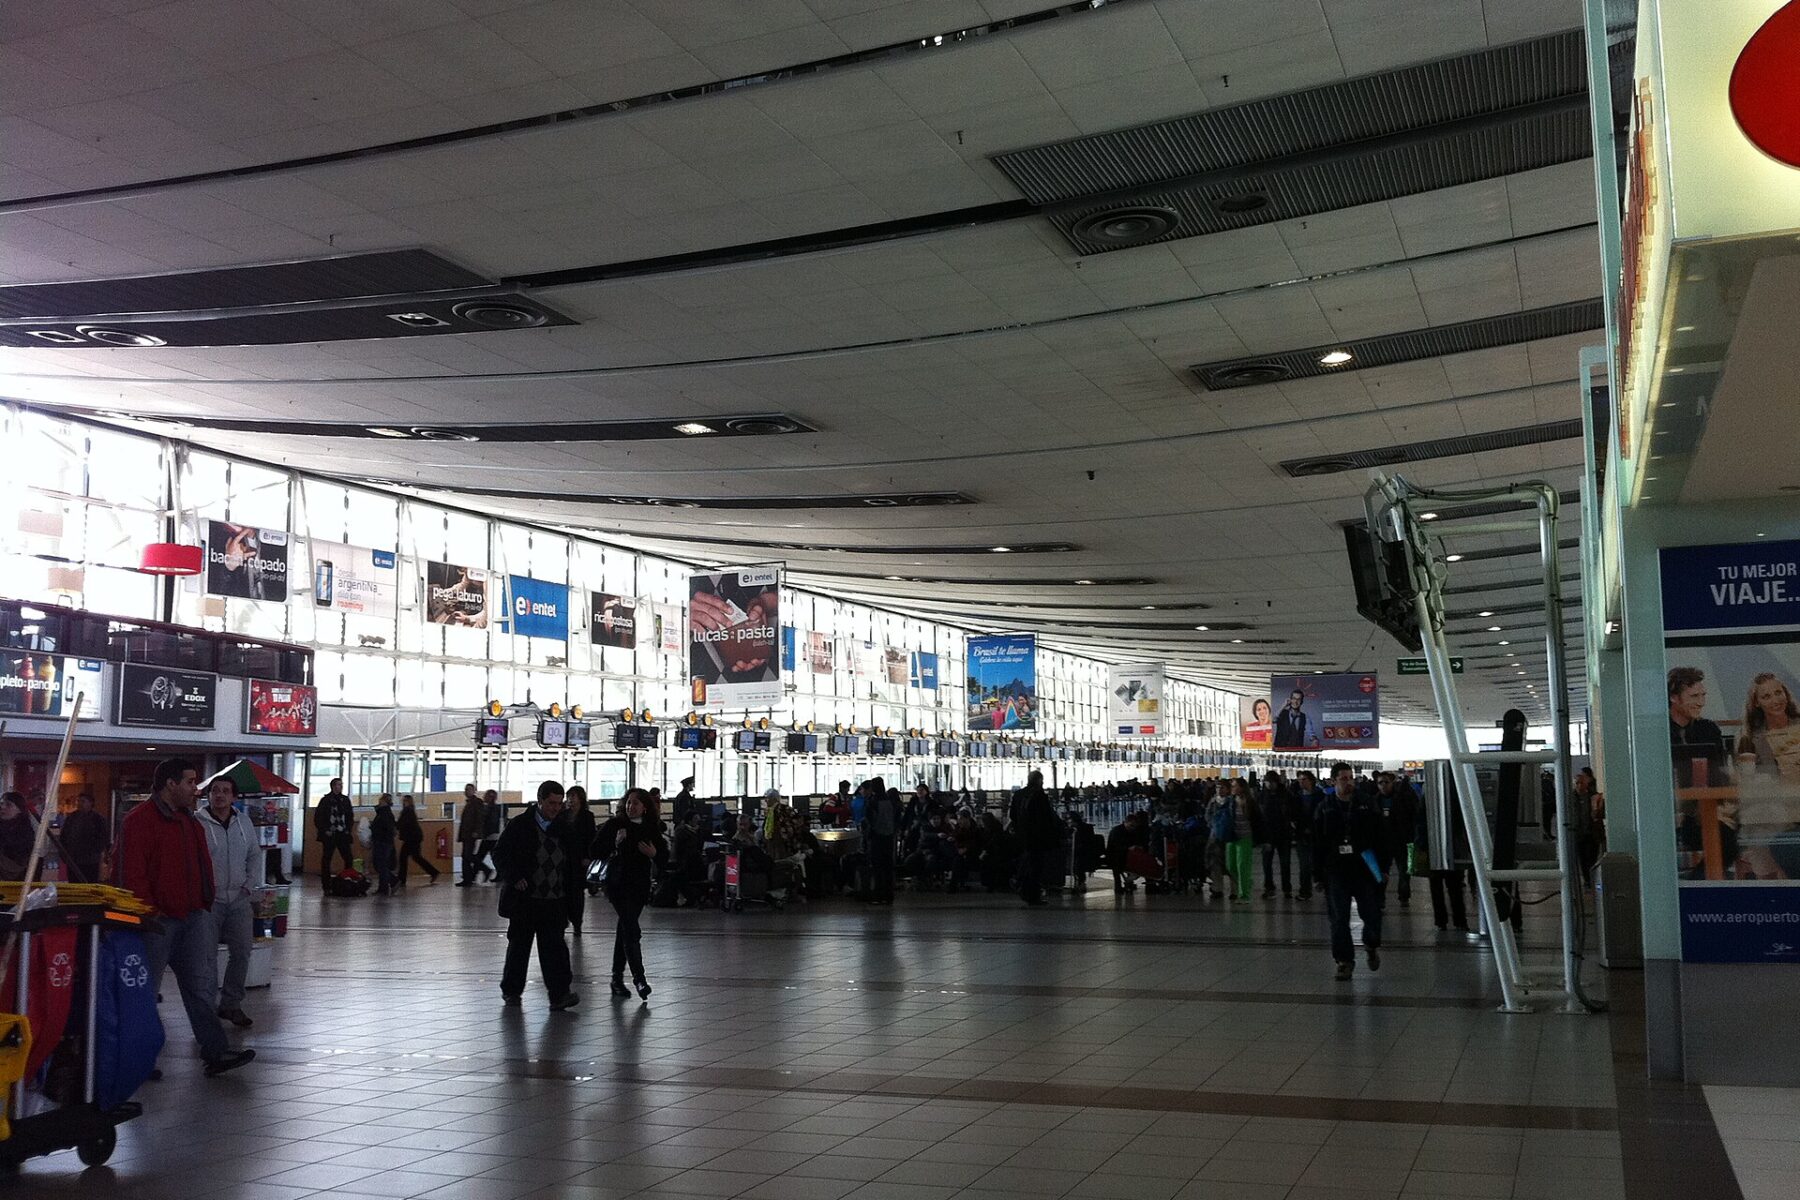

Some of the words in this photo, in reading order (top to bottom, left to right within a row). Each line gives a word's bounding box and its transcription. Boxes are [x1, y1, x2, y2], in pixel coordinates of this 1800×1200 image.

[247, 558, 286, 573] copado
[1718, 566, 1738, 580] TU
[1742, 562, 1797, 578] MEJOR
[754, 573, 773, 582] entel
[532, 602, 557, 618] entel
[737, 624, 775, 643] pasta
[184, 694, 206, 702] EDOX
